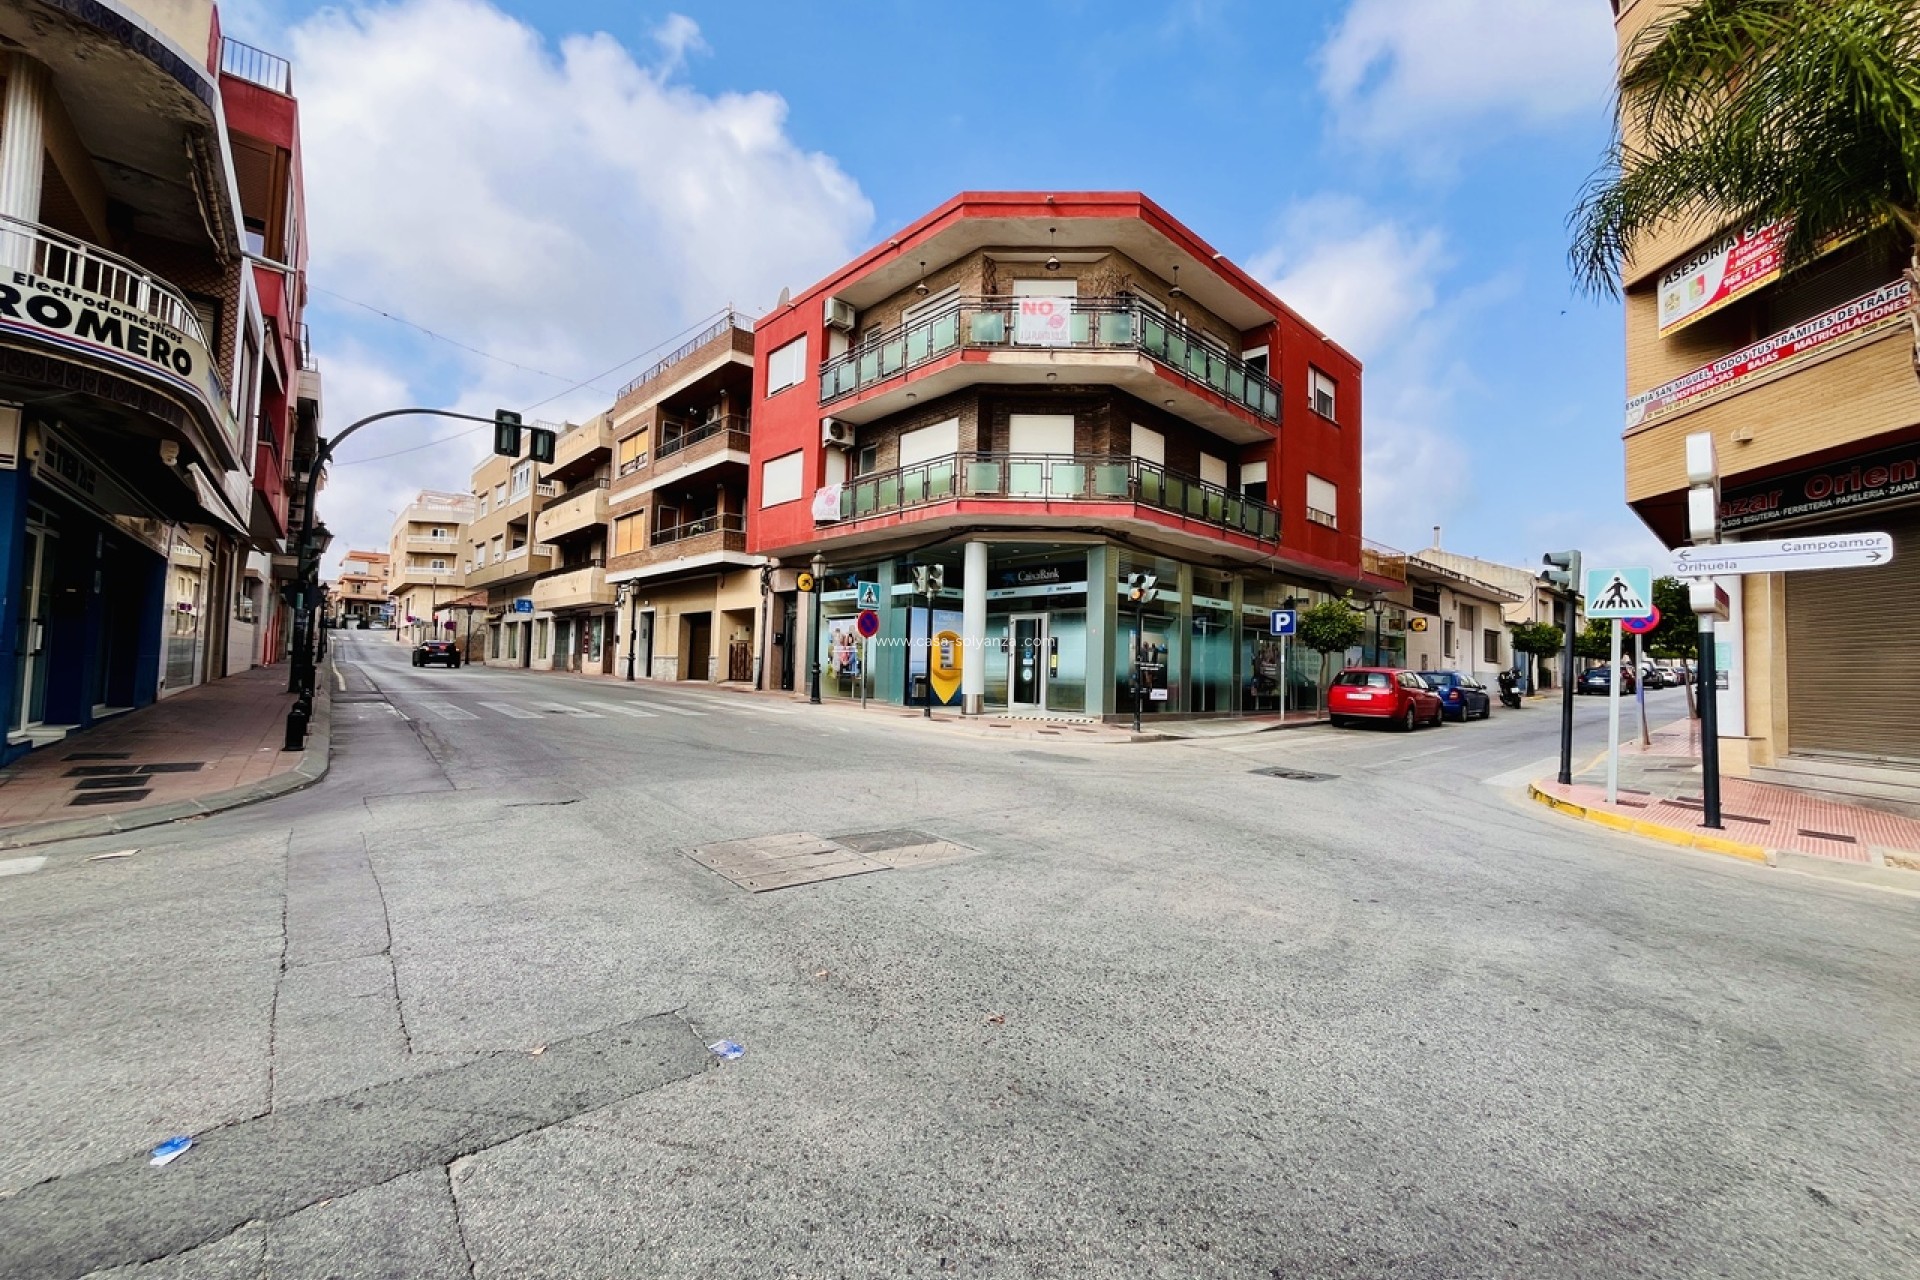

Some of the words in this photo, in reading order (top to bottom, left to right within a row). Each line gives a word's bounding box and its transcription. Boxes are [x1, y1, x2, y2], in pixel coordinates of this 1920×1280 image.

[13, 271, 183, 344] Electrodomésticos
[1021, 301, 1054, 316] NO
[1747, 350, 1779, 370] BAJAS
[1793, 297, 1912, 351] MATRICULACIONES
[1655, 385, 1673, 398] SAN
[1715, 351, 1748, 373] TODOS
[1753, 342, 1771, 358] TUS
[1837, 306, 1855, 320] DE
[1804, 457, 1920, 500] Orien
[1783, 499, 1833, 515] FERRETERIA
[1836, 489, 1885, 504] PAPELERIA
[1781, 537, 1883, 552] Campoamor
[1677, 561, 1738, 572] Orihuela
[1275, 612, 1291, 632] P
